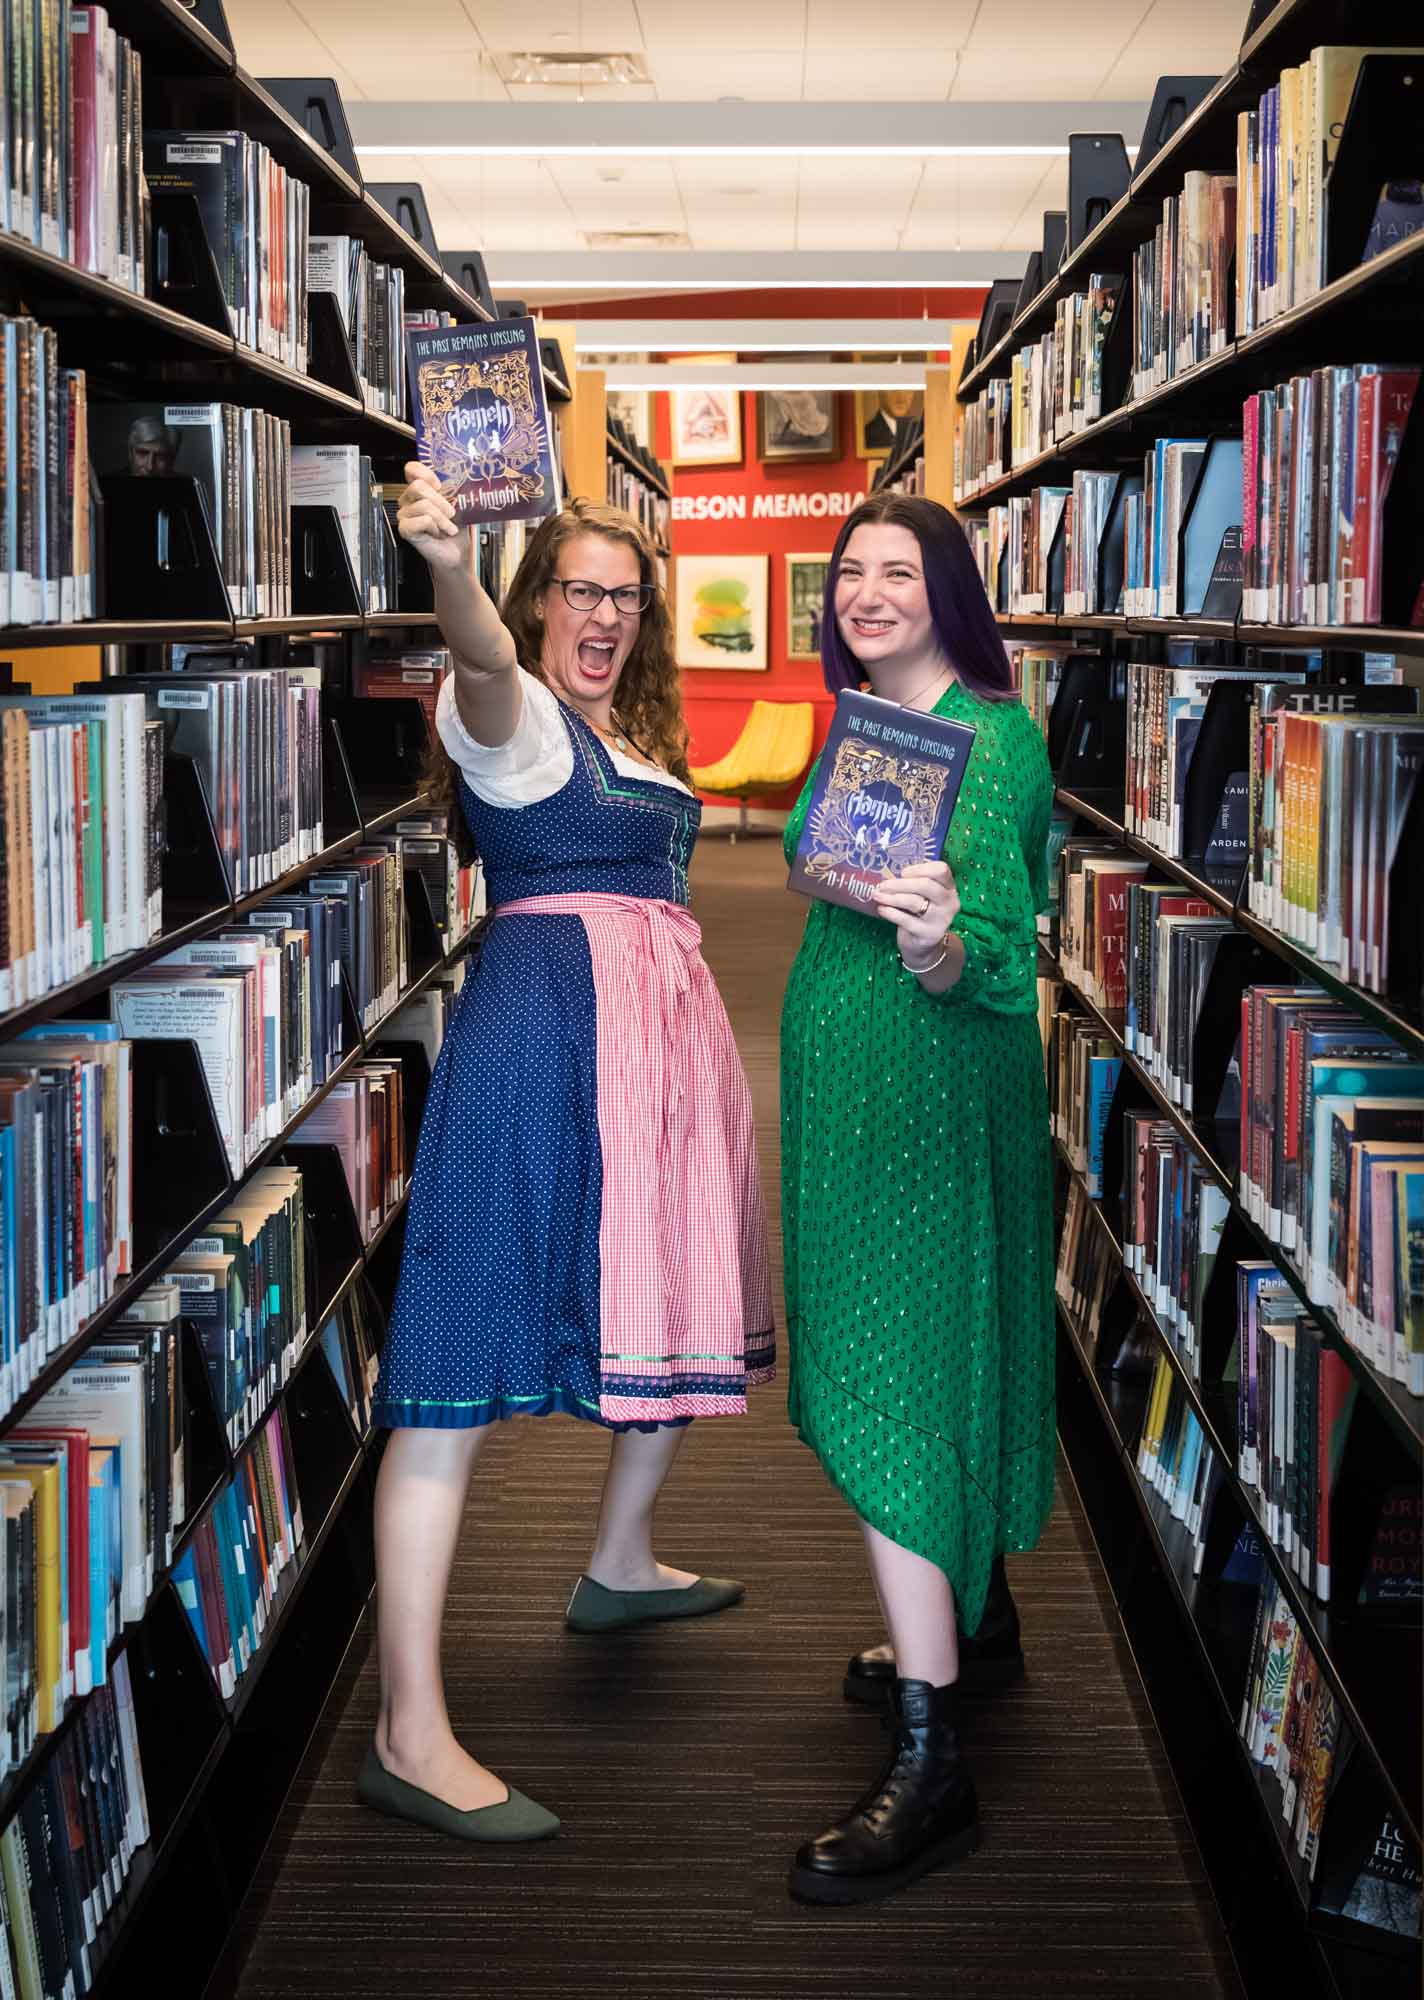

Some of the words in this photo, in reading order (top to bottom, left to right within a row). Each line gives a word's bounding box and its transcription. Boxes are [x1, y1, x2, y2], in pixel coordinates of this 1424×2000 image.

[416, 340, 430, 357] THE
[432, 338, 450, 354] PAST
[451, 333, 489, 351] REMAINS
[490, 329, 526, 346] UNSUNG
[671, 495, 747, 520] ERSON
[847, 715, 862, 732] THE
[863, 720, 882, 737] PAST
[882, 726, 919, 748] REMAINS
[920, 737, 956, 760] UNSUNG
